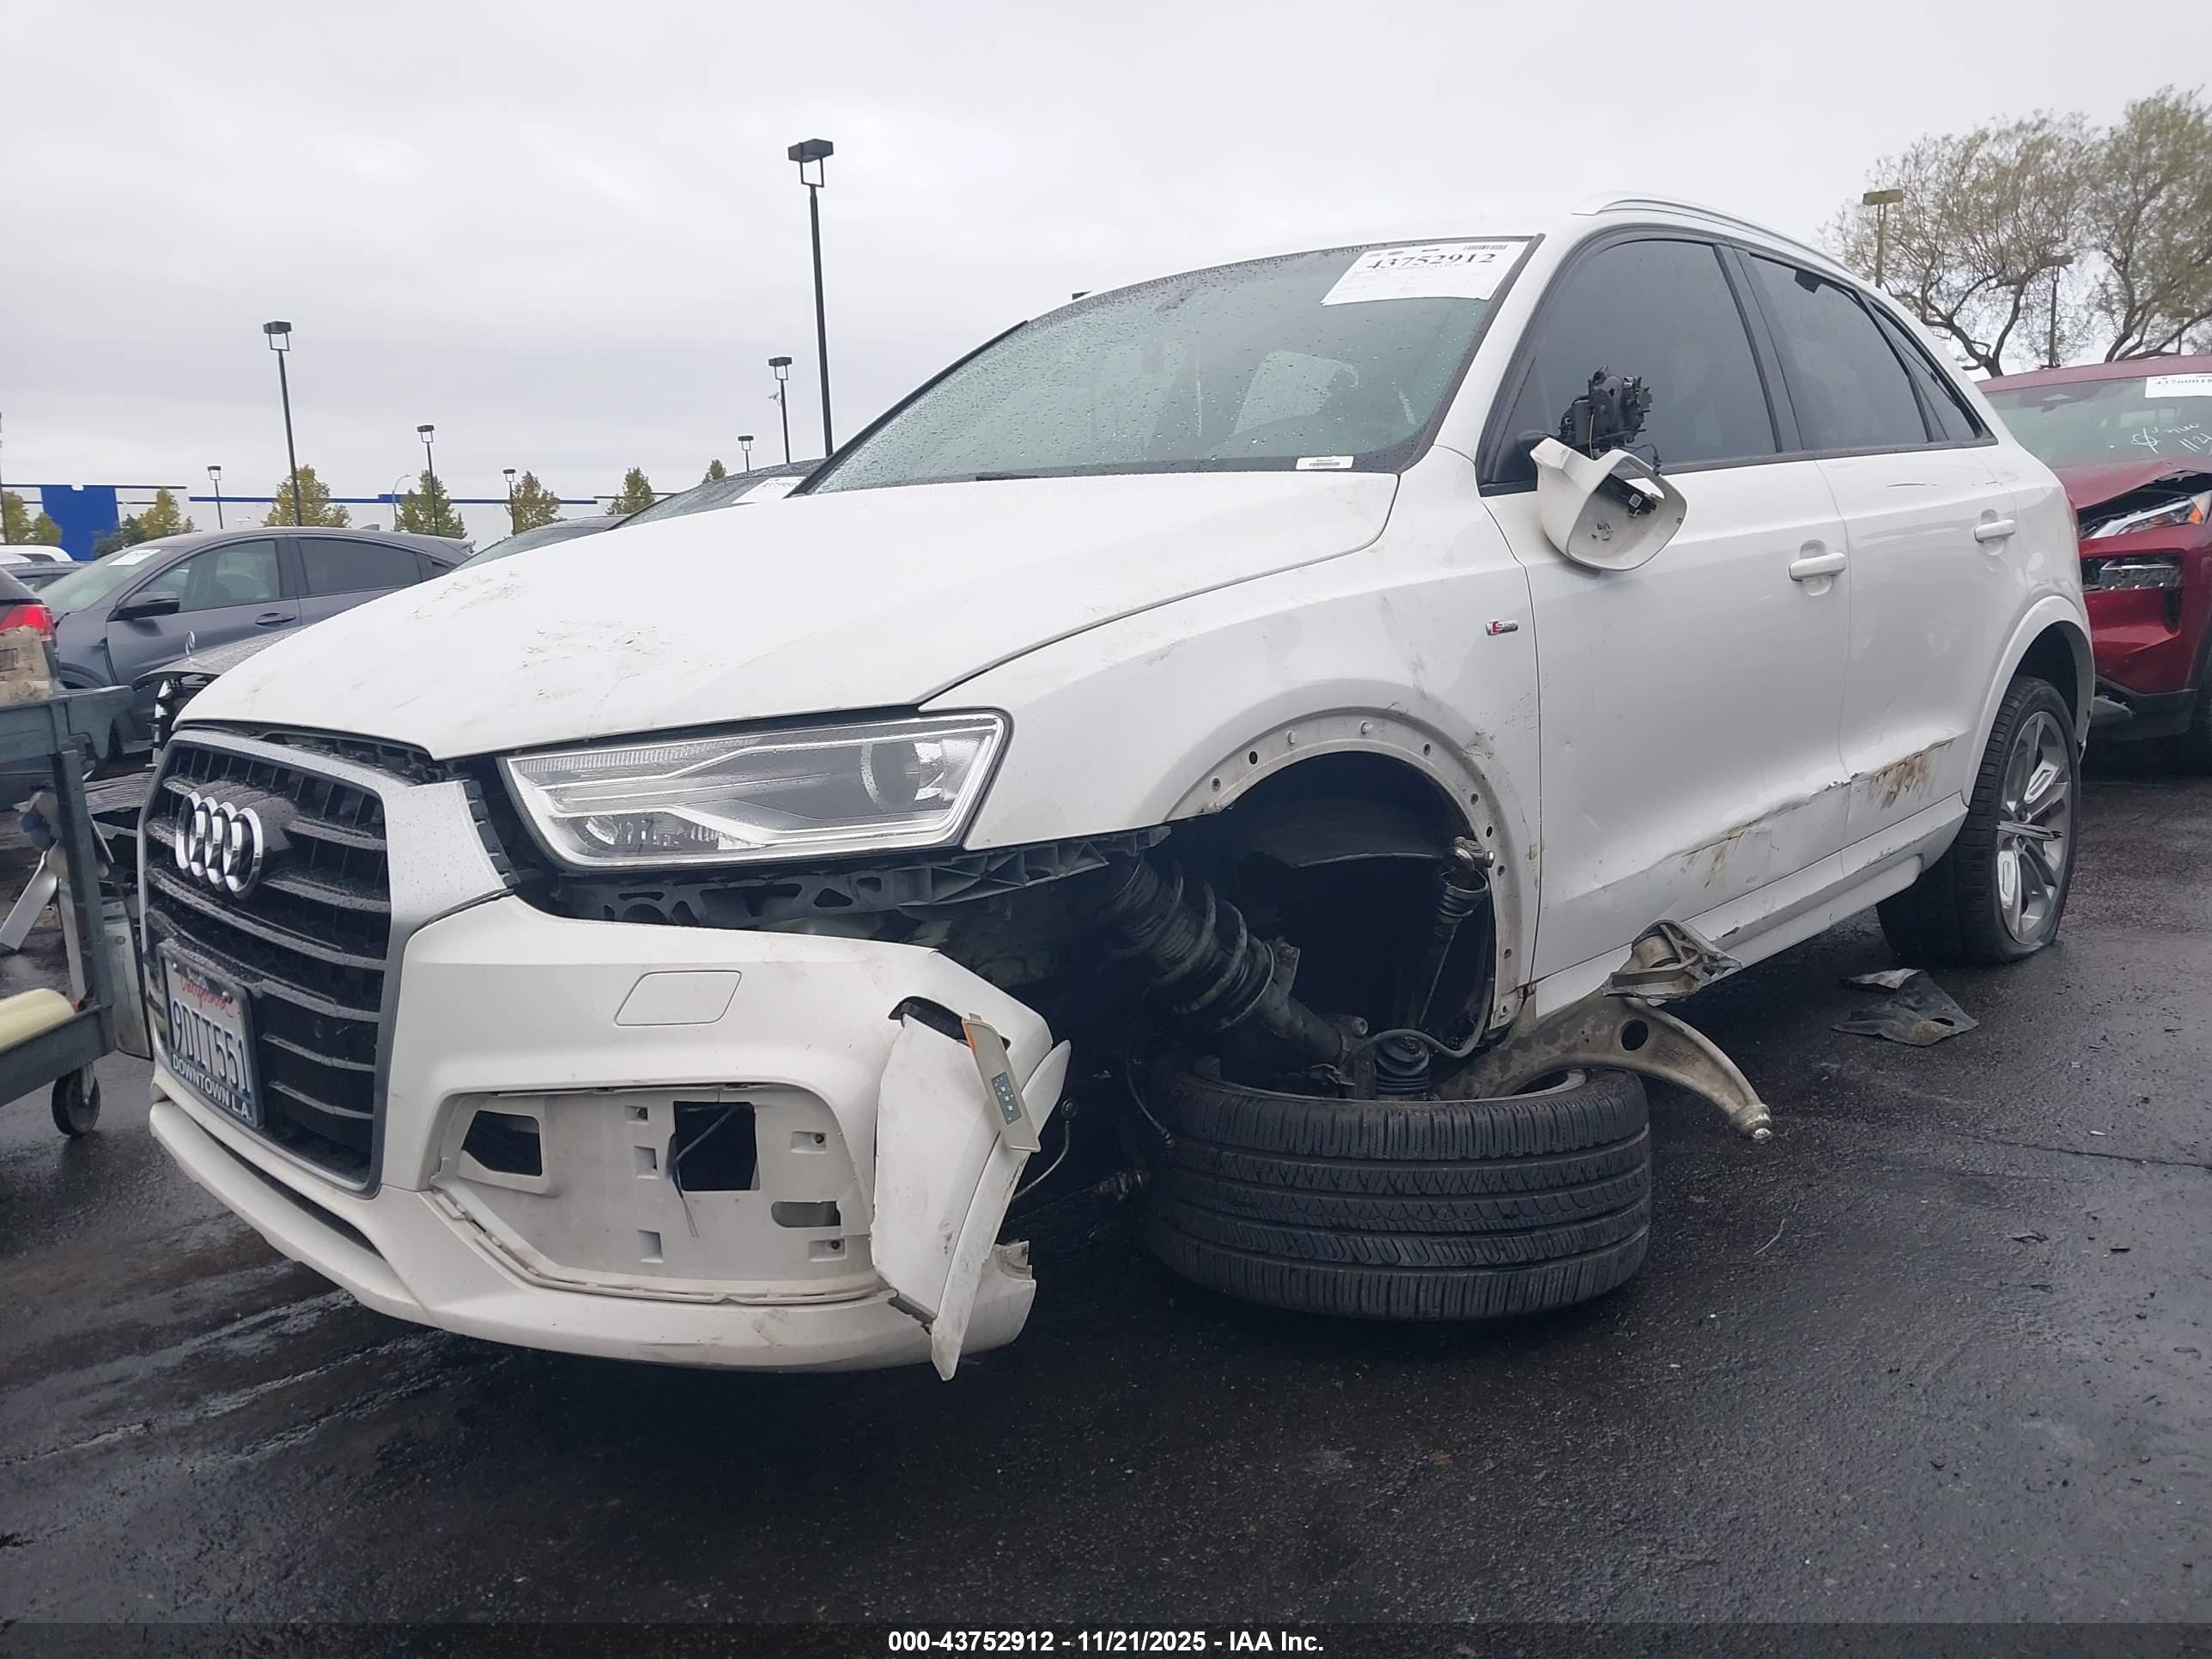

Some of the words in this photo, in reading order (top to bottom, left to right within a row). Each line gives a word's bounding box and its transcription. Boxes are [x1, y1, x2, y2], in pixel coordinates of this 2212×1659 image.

[1366, 253, 1497, 270] 43752912
[172, 1053, 230, 1108] DOWNTOWN
[231, 1096, 253, 1122] L.A.
